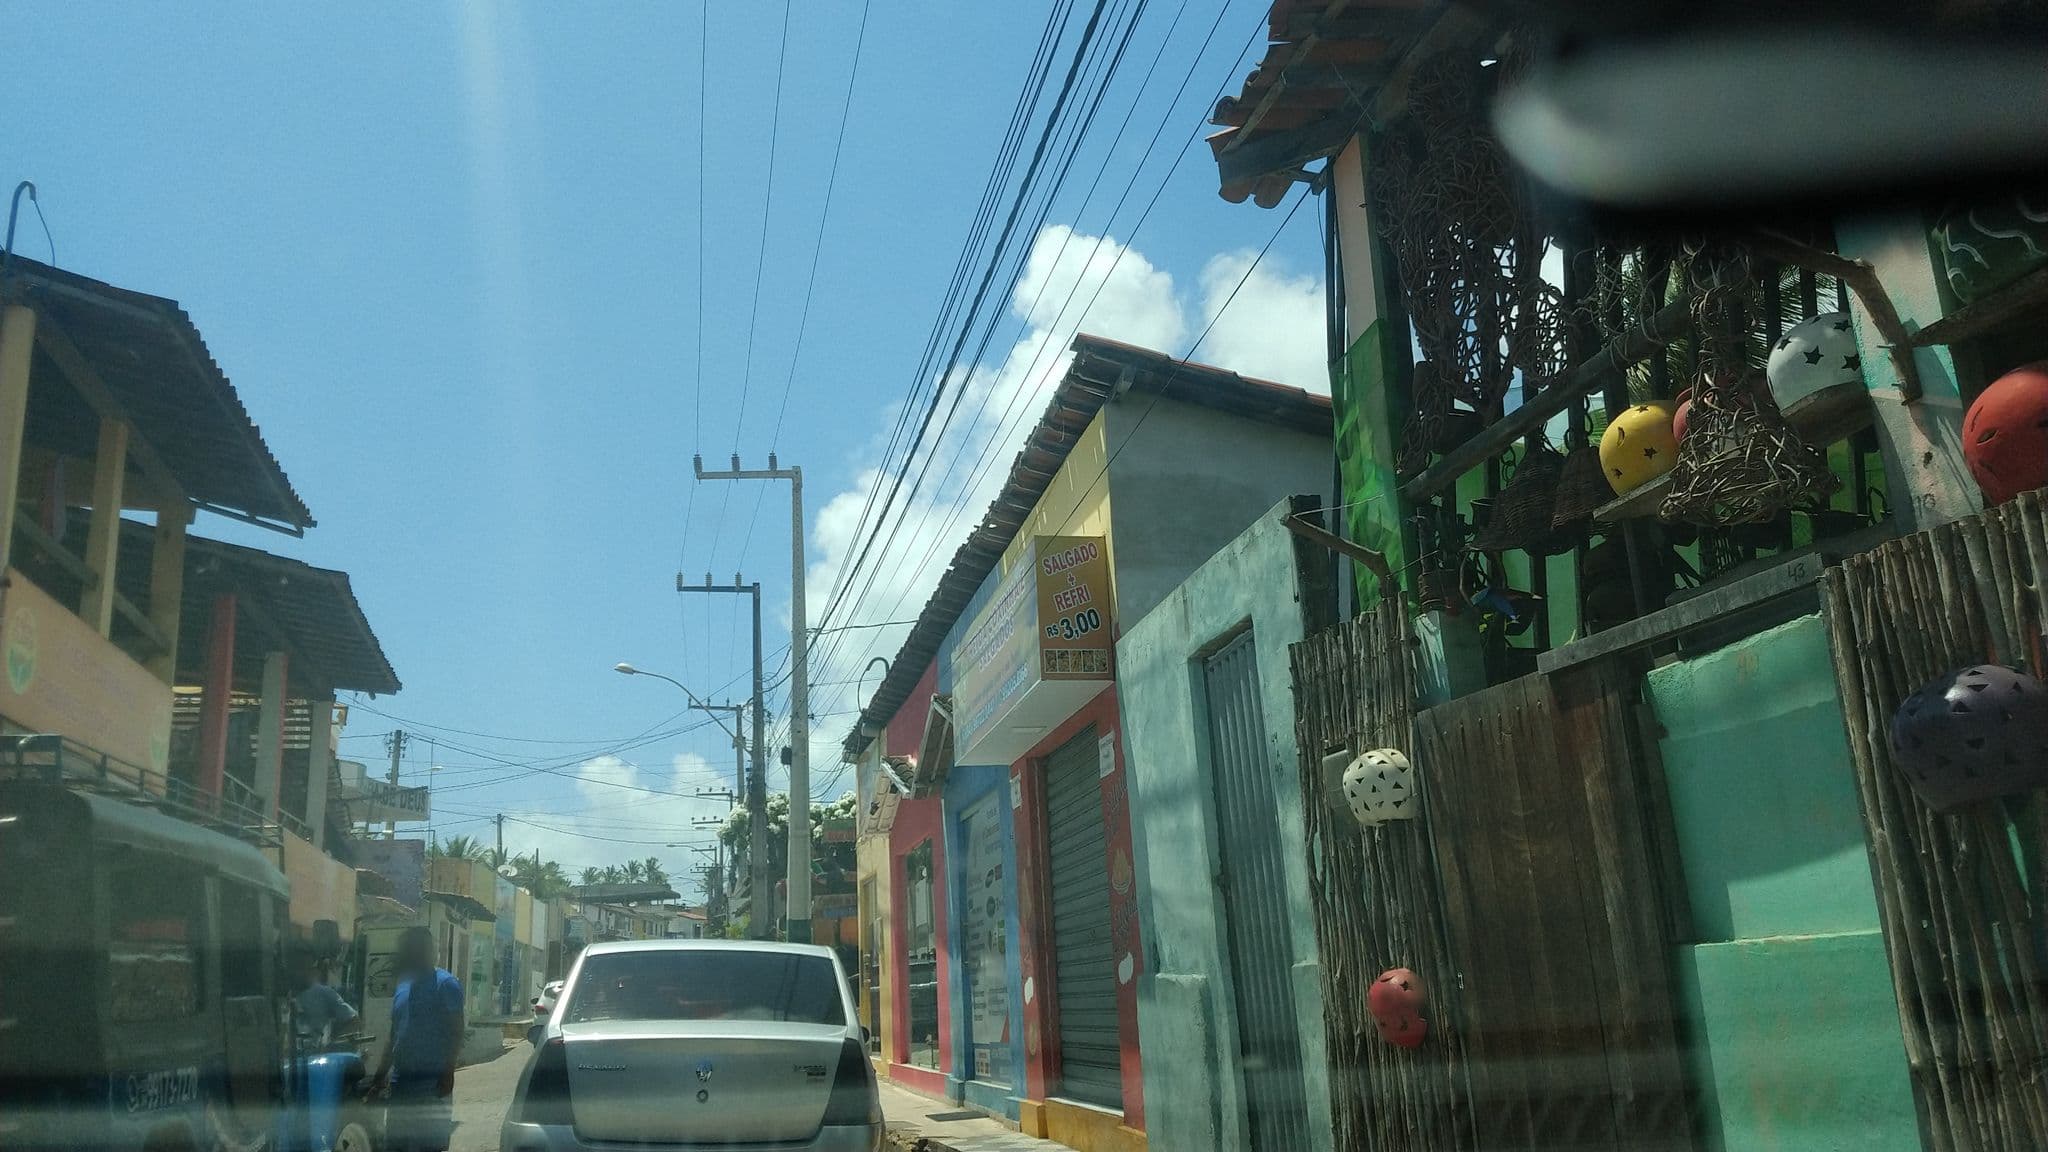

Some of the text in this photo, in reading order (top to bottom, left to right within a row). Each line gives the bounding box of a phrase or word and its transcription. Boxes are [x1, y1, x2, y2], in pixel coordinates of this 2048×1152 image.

[1043, 542, 1098, 575] SALGADO
[1054, 585, 1091, 611] REFRI
[1060, 608, 1100, 640] 3,00
